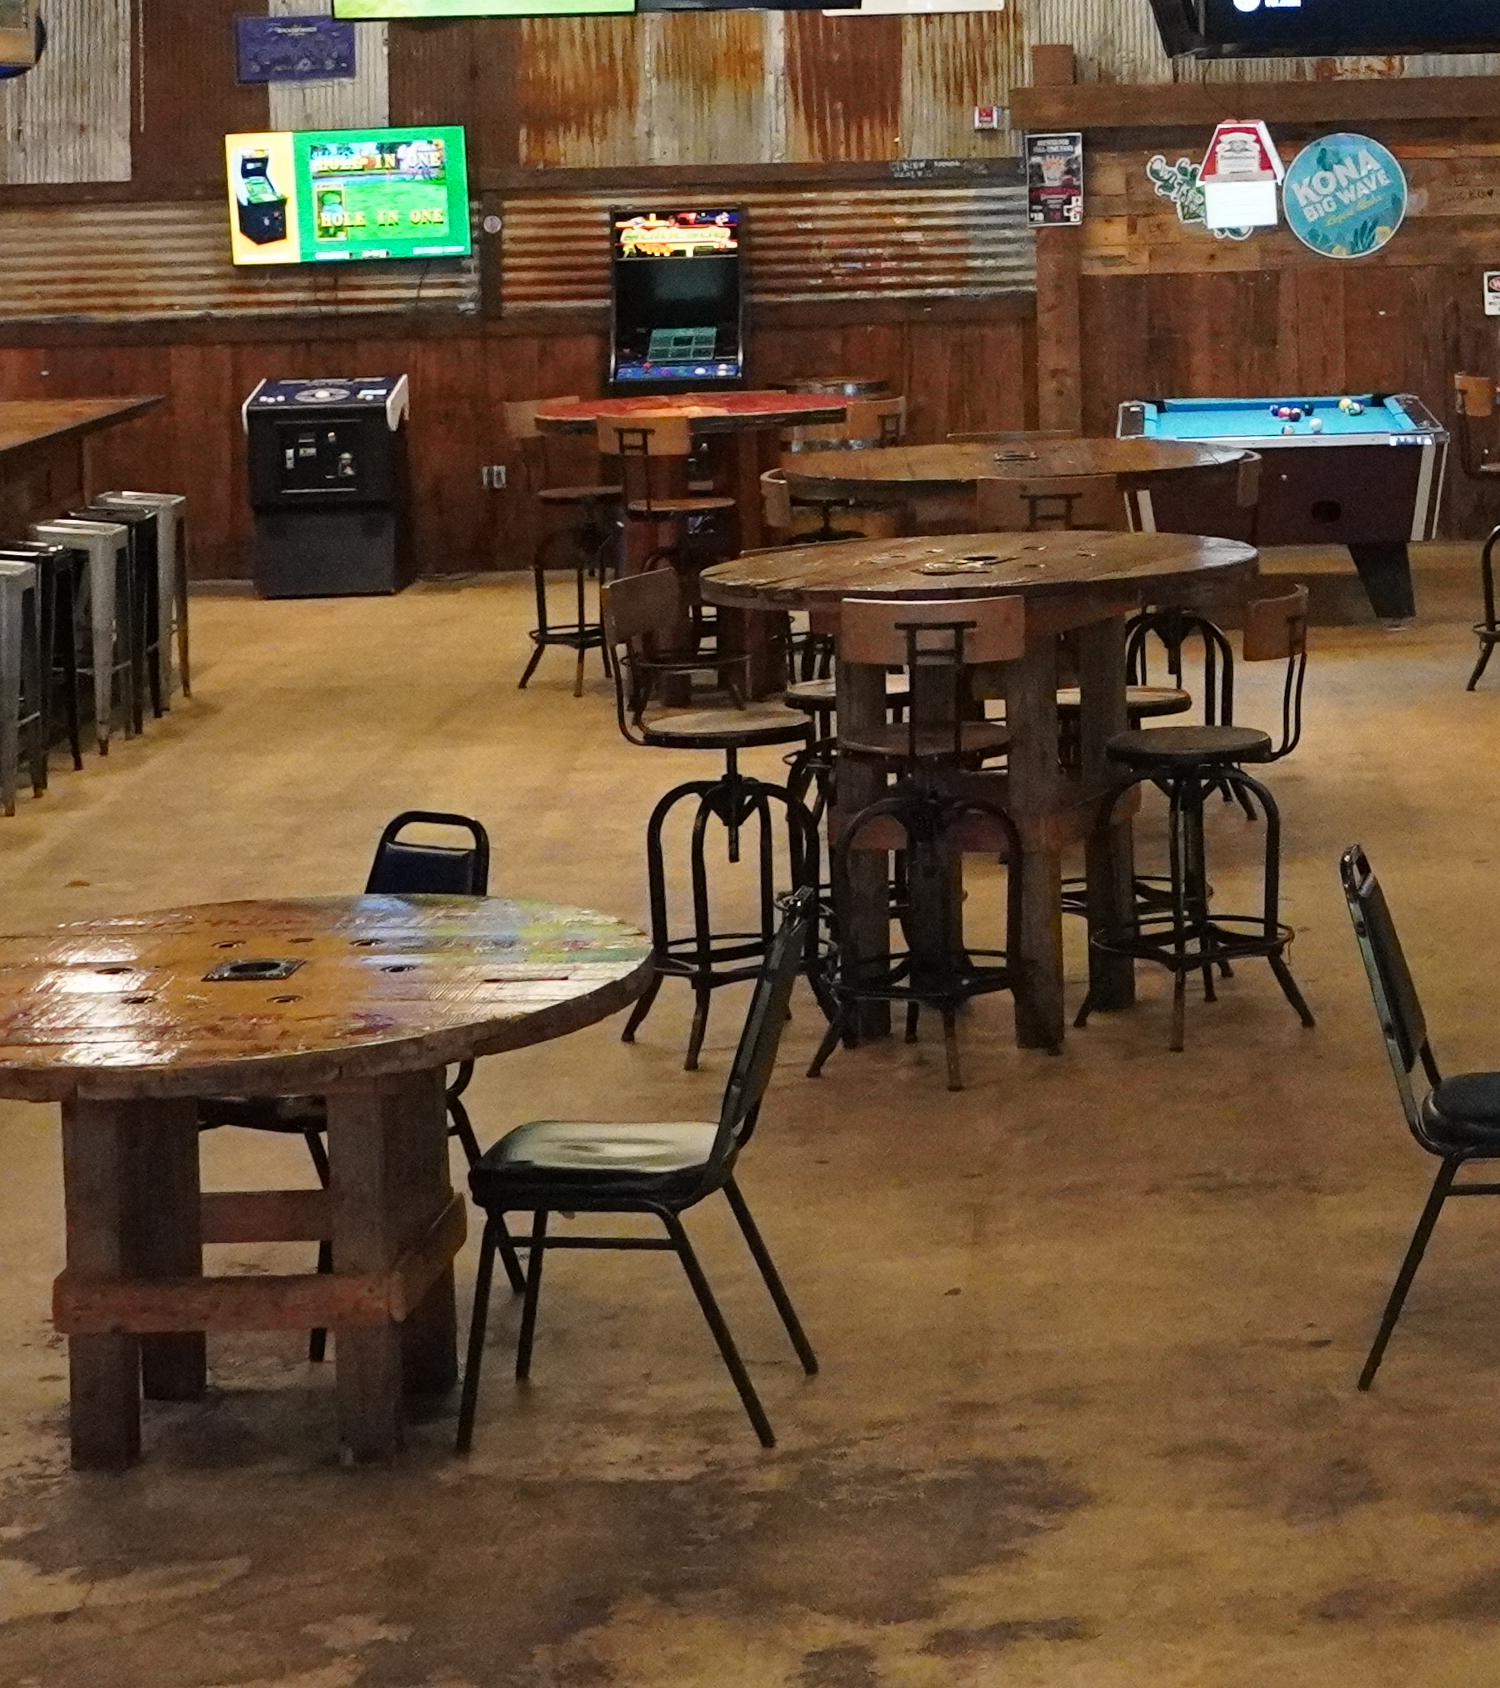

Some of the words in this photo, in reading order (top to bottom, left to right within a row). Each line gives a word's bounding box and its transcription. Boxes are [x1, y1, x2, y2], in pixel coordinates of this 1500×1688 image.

[375, 154, 396, 170] IN
[408, 152, 441, 168] ONE
[1291, 148, 1382, 208] KONA
[1302, 196, 1337, 223] BIG
[1335, 169, 1391, 205] WAVE
[320, 210, 366, 228] HOLE
[378, 210, 399, 227] IN
[410, 209, 444, 225] ONE
